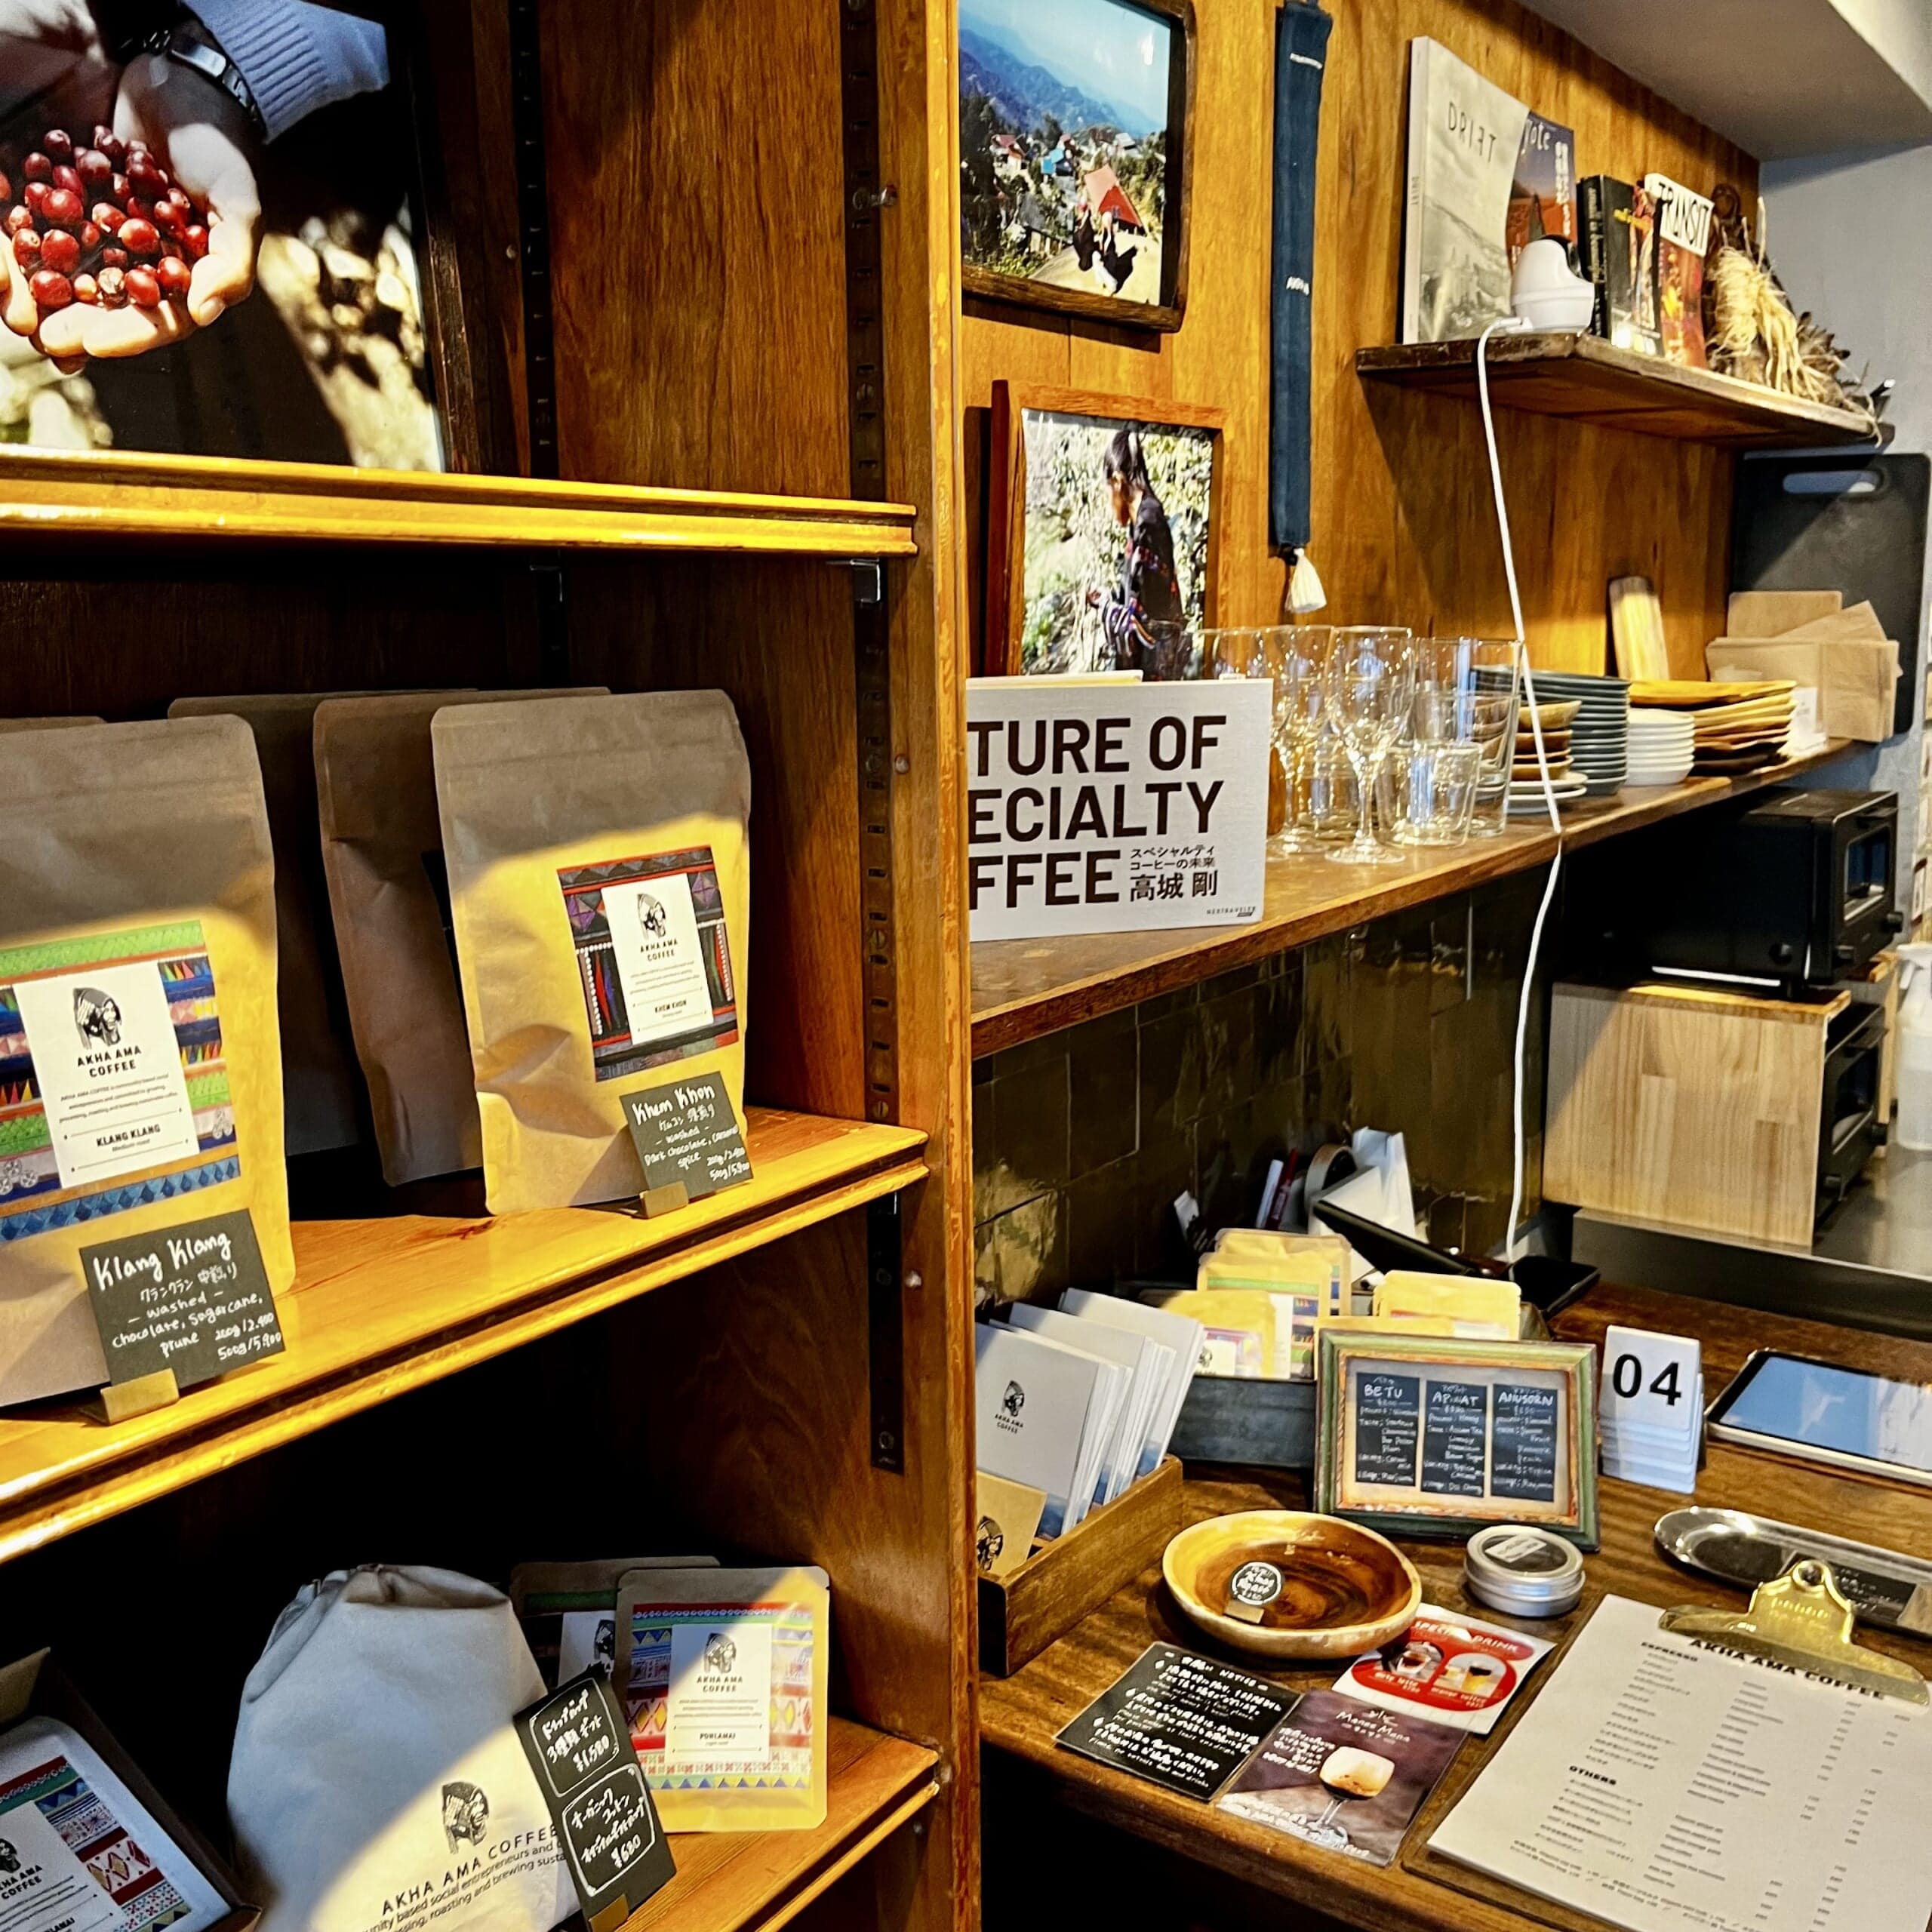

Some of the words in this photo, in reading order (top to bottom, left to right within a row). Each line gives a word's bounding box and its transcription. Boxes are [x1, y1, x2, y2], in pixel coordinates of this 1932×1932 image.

[1447, 102, 1497, 163] DRIFT
[1659, 182, 1709, 249] TRANSIT
[967, 718, 1131, 777] TURE
[1149, 715, 1226, 771] OF
[968, 780, 1224, 844] ECIALTY
[1131, 845, 1215, 859] スペシャルティ
[1131, 857, 1216, 871] コーヒーの未来
[968, 850, 1121, 910] FFEE
[1131, 872, 1183, 902] 高城
[1192, 870, 1217, 897] 剛
[647, 949, 675, 961] COFFEE
[77, 1051, 112, 1068] AKHA
[115, 1045, 142, 1060] AMA
[89, 1060, 136, 1078] COFFEE
[632, 1100, 673, 1125] Khem
[674, 1085, 715, 1109] Khon
[97, 1132, 128, 1147] KLANG
[131, 1124, 161, 1139] KLANG
[94, 1252, 163, 1291] Klang
[168, 1233, 231, 1270] Klang
[141, 1281, 193, 1303] クランクラン
[146, 1291, 207, 1319] washed
[160, 1332, 200, 1358] prune
[1613, 1354, 1682, 1407] 04
[1472, 1635, 1519, 1653] DRINK
[1689, 1639, 1746, 1661] AKHA
[1751, 1657, 1796, 1675] AMA
[697, 1675, 721, 1684] AKHA
[1569, 1765, 1617, 1786] OTHERS
[602, 1795, 629, 1824] コットン
[0, 1876, 18, 1891] HA
[20, 1865, 42, 1880] AMA
[382, 1881, 433, 1916] AKHA
[443, 1857, 481, 1887] AMA
[488, 1824, 557, 1859] COFFEE
[396, 1898, 428, 1923] based
[431, 1882, 459, 1906] social
[532, 1841, 553, 1855] and
[2, 1875, 42, 1900] COFFEE
[430, 1893, 472, 1919] roasting
[474, 1879, 491, 1897] and
[493, 1860, 534, 1885] brewing
